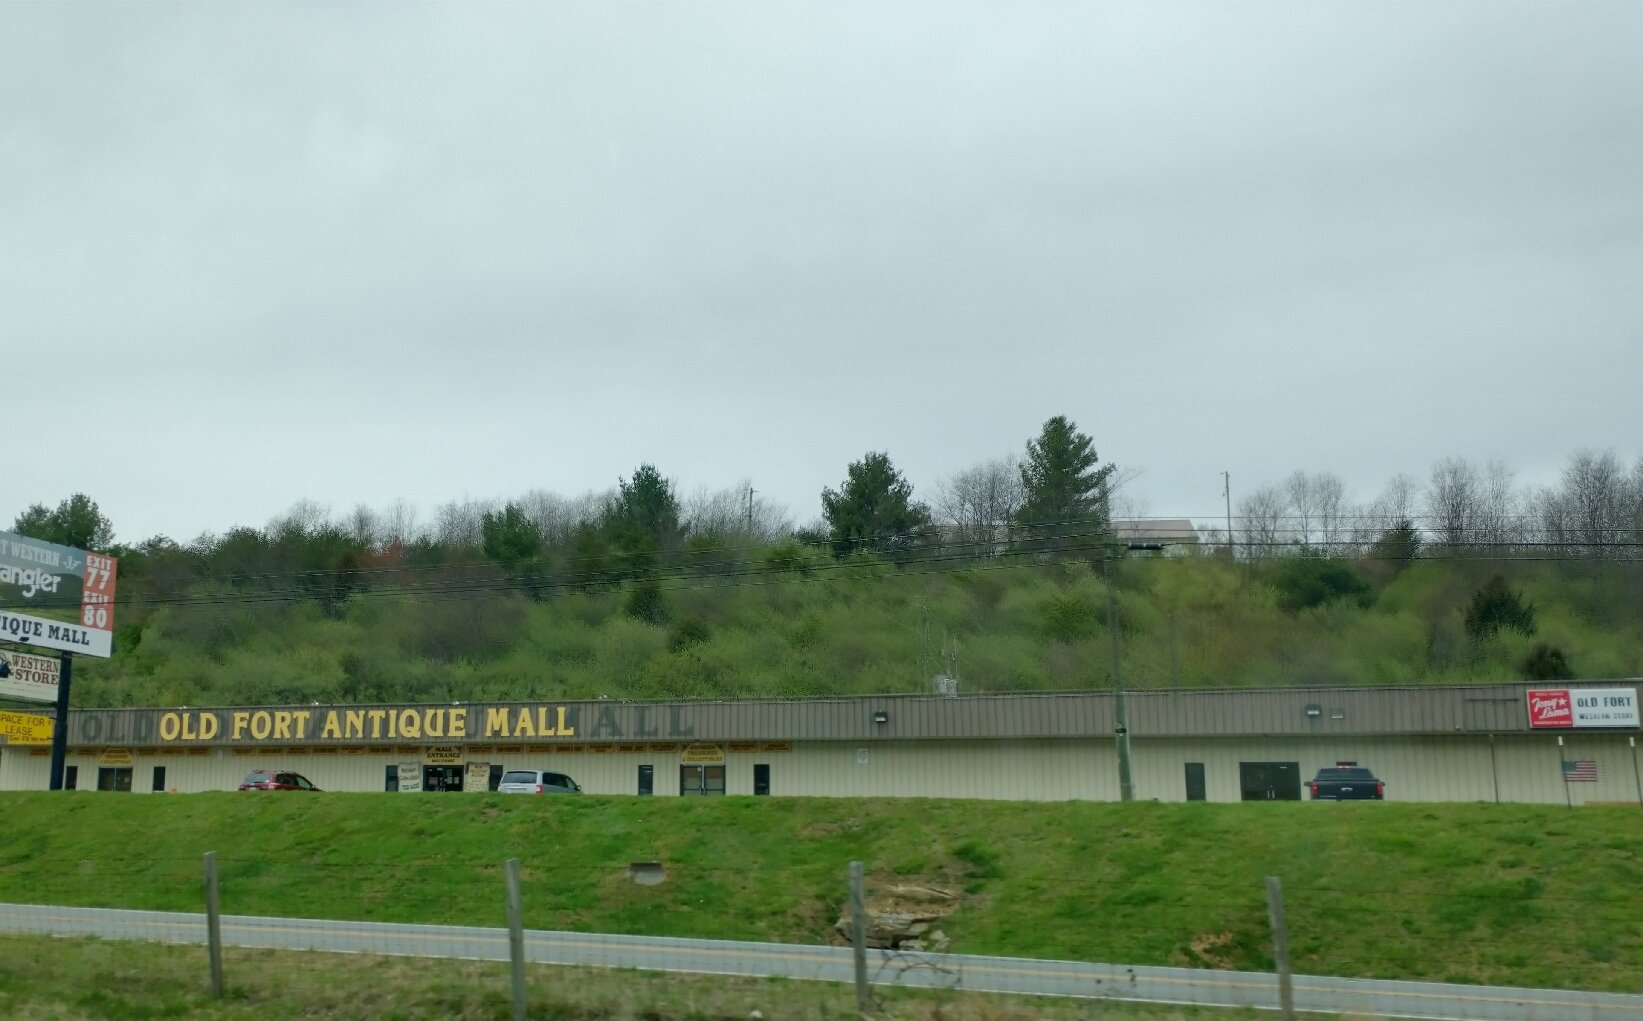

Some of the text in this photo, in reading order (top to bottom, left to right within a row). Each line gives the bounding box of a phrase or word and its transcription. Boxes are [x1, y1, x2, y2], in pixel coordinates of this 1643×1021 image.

[11, 541, 61, 567] WESTERN
[87, 555, 112, 571] EXIT
[87, 567, 110, 590] 77
[84, 591, 109, 606] EXIT
[83, 605, 107, 628] 80
[0, 615, 90, 646] IQUE MALL
[12, 655, 59, 673] WESTERN
[15, 668, 58, 685] STORE
[1577, 697, 1632, 707] OLD FORT
[0, 713, 45, 727] PACE FOR
[160, 706, 574, 741] OLD FORT ANTIQUE MALL
[5, 725, 33, 736] LEASE
